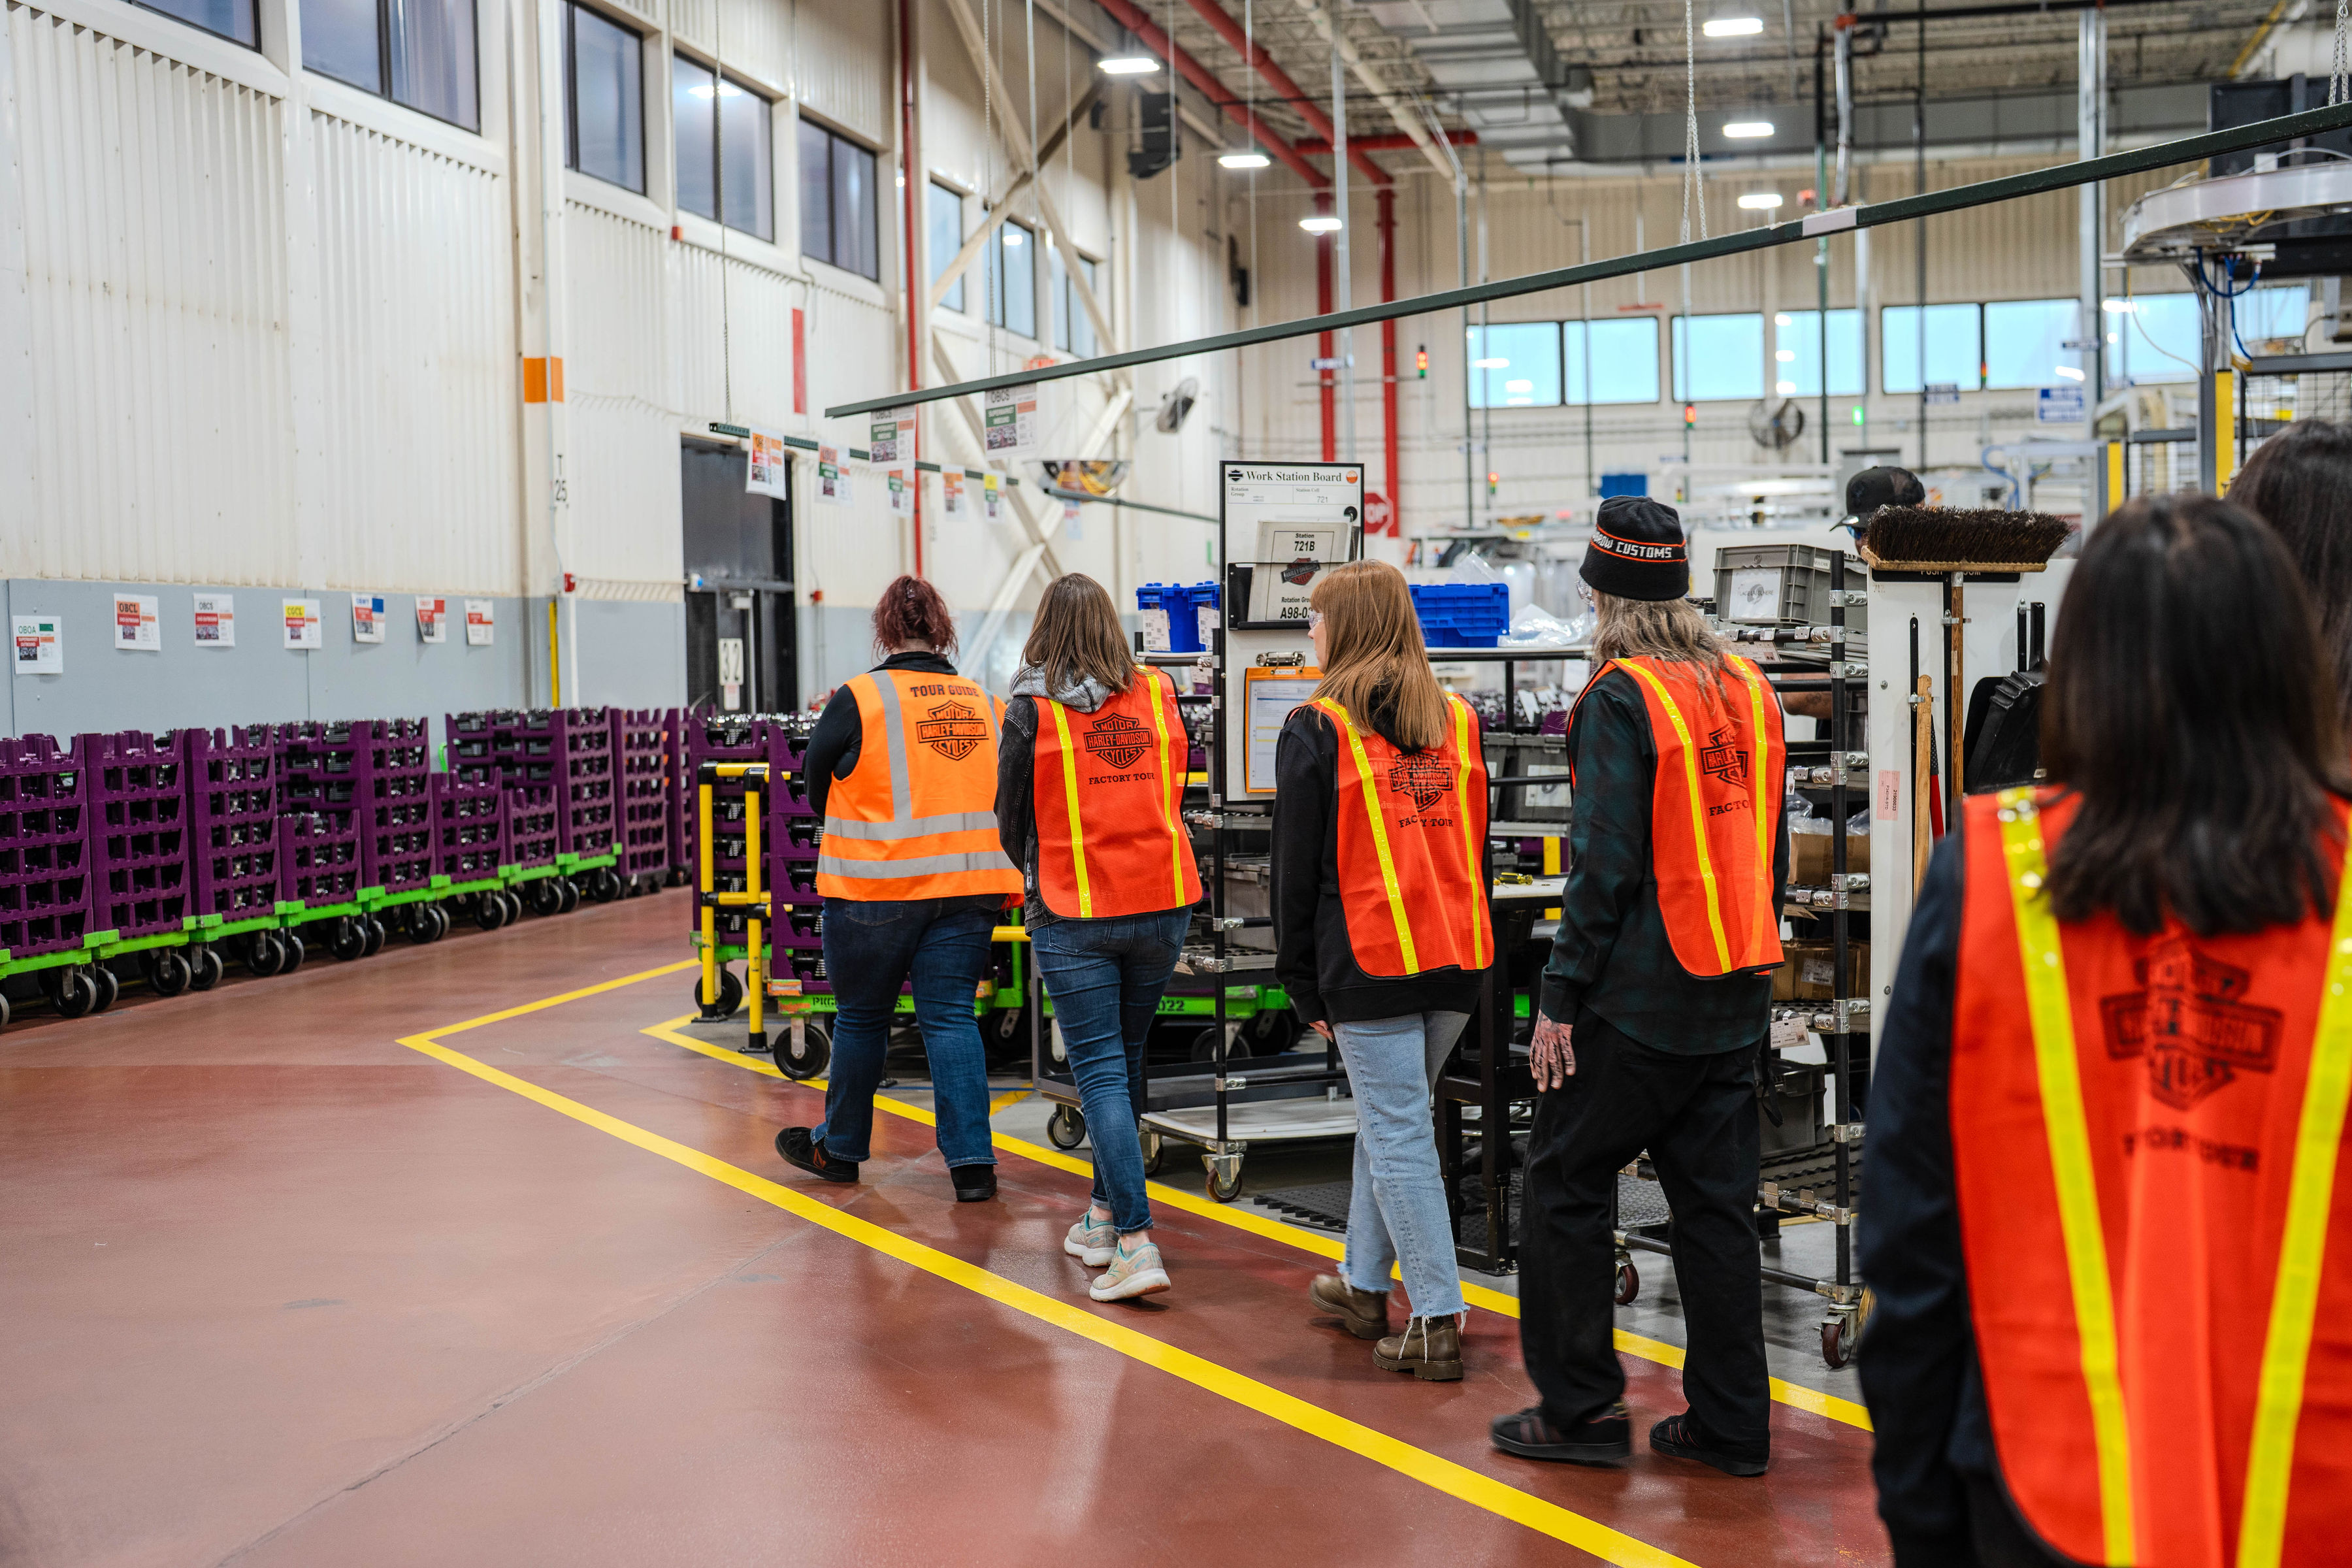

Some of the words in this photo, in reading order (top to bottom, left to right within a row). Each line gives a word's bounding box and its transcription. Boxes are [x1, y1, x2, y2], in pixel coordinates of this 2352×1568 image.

[1247, 470, 1273, 482] Work
[1276, 471, 1310, 482] Station
[1313, 472, 1342, 482] Board
[1364, 502, 1389, 524] OP
[1294, 541, 1315, 551] 721B
[1615, 542, 1673, 559] CUSTOMS
[119, 603, 138, 613] OBCL
[18, 625, 37, 634] OBOA
[910, 685, 945, 697] TOUR
[948, 685, 979, 697] GUIDE
[936, 704, 970, 720] MOTOR
[922, 723, 985, 738] HARLEY-DAVIDSON
[1101, 718, 1134, 731] MOTOR
[1087, 732, 1149, 747] HARLEY-DAVIDSON
[938, 739, 972, 757] CYCLES
[1102, 747, 1137, 765] CYCLES
[1088, 774, 1131, 785] FACTORY
[1133, 773, 1155, 781] TOUR
[1708, 800, 1750, 817] FACTO
